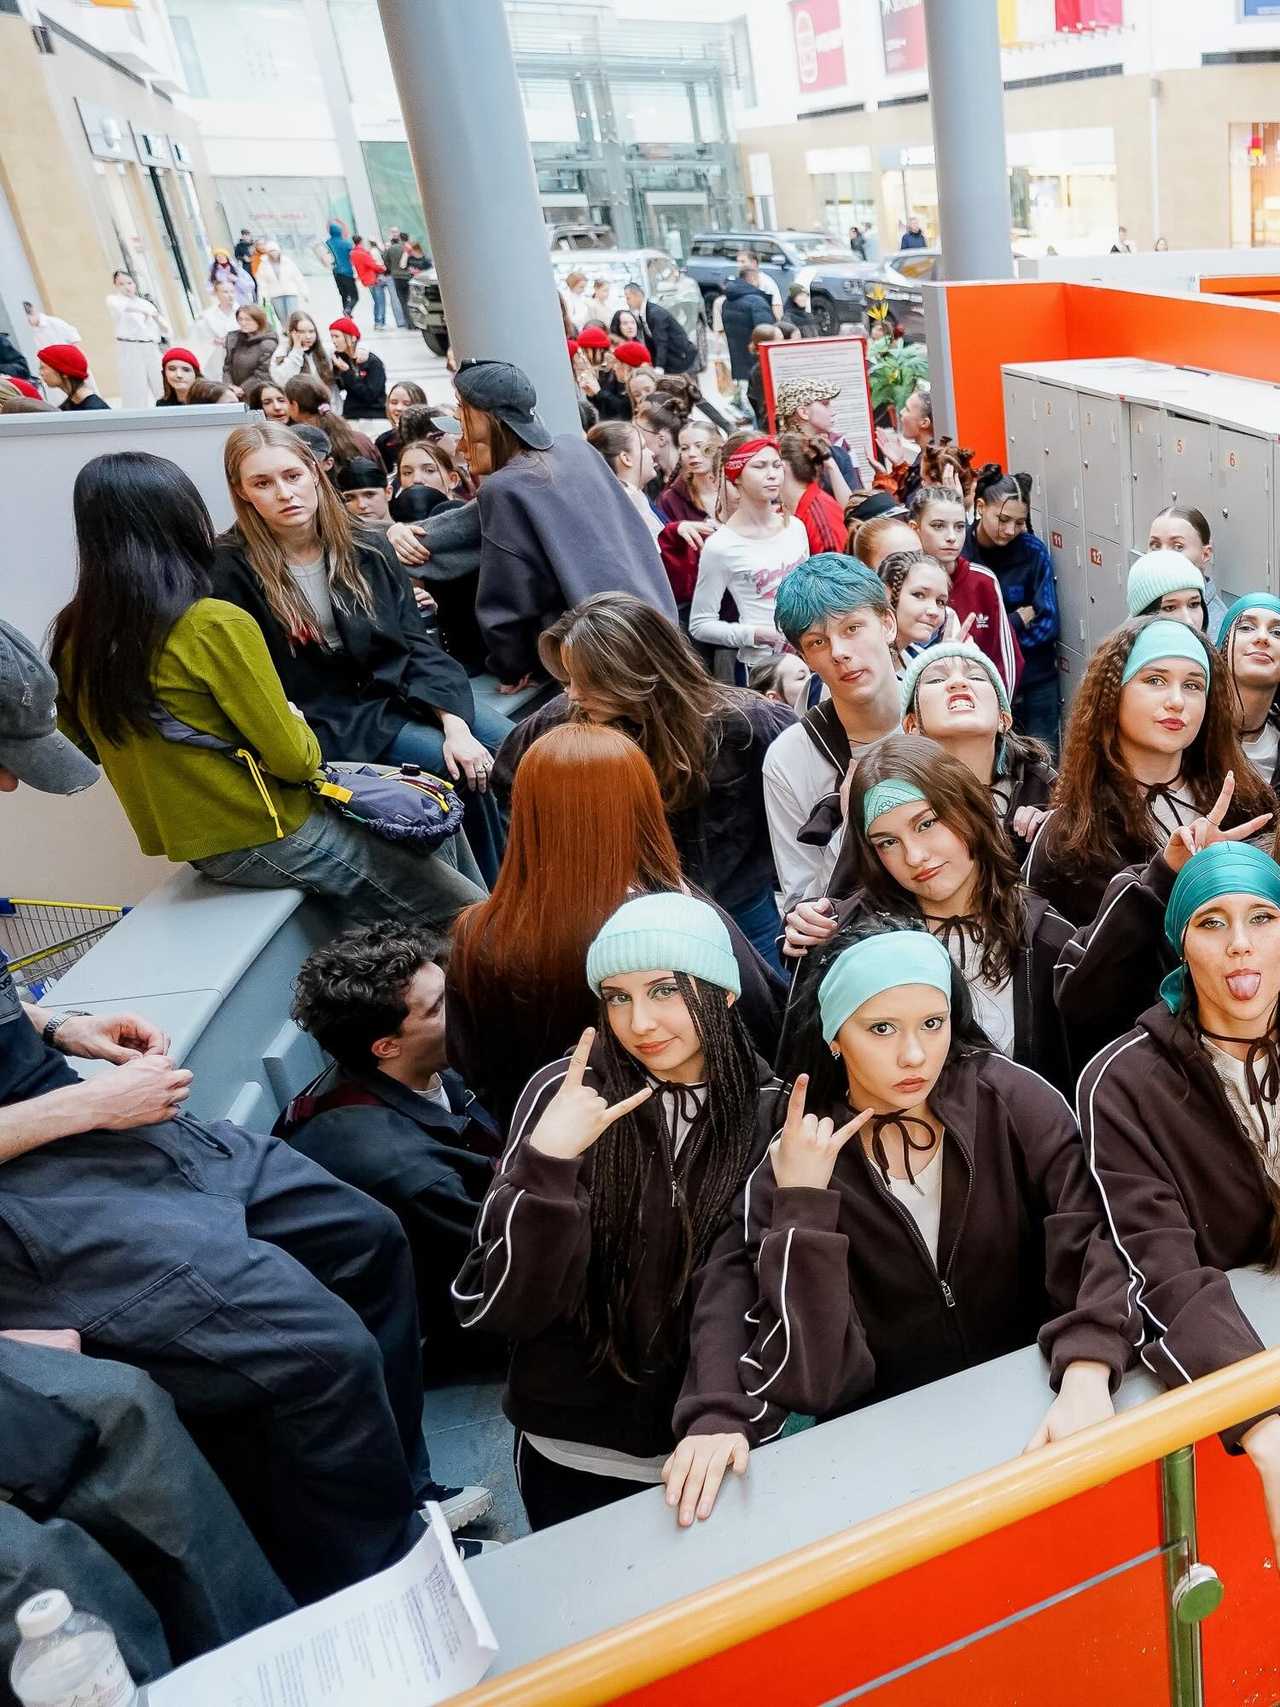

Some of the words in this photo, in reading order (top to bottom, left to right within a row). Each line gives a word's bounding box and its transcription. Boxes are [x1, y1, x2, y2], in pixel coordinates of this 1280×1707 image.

[1177, 439, 1182, 453] 5
[1229, 452, 1236, 467] 6
[1054, 534, 1062, 546] 11
[1092, 551, 1102, 564] 12
